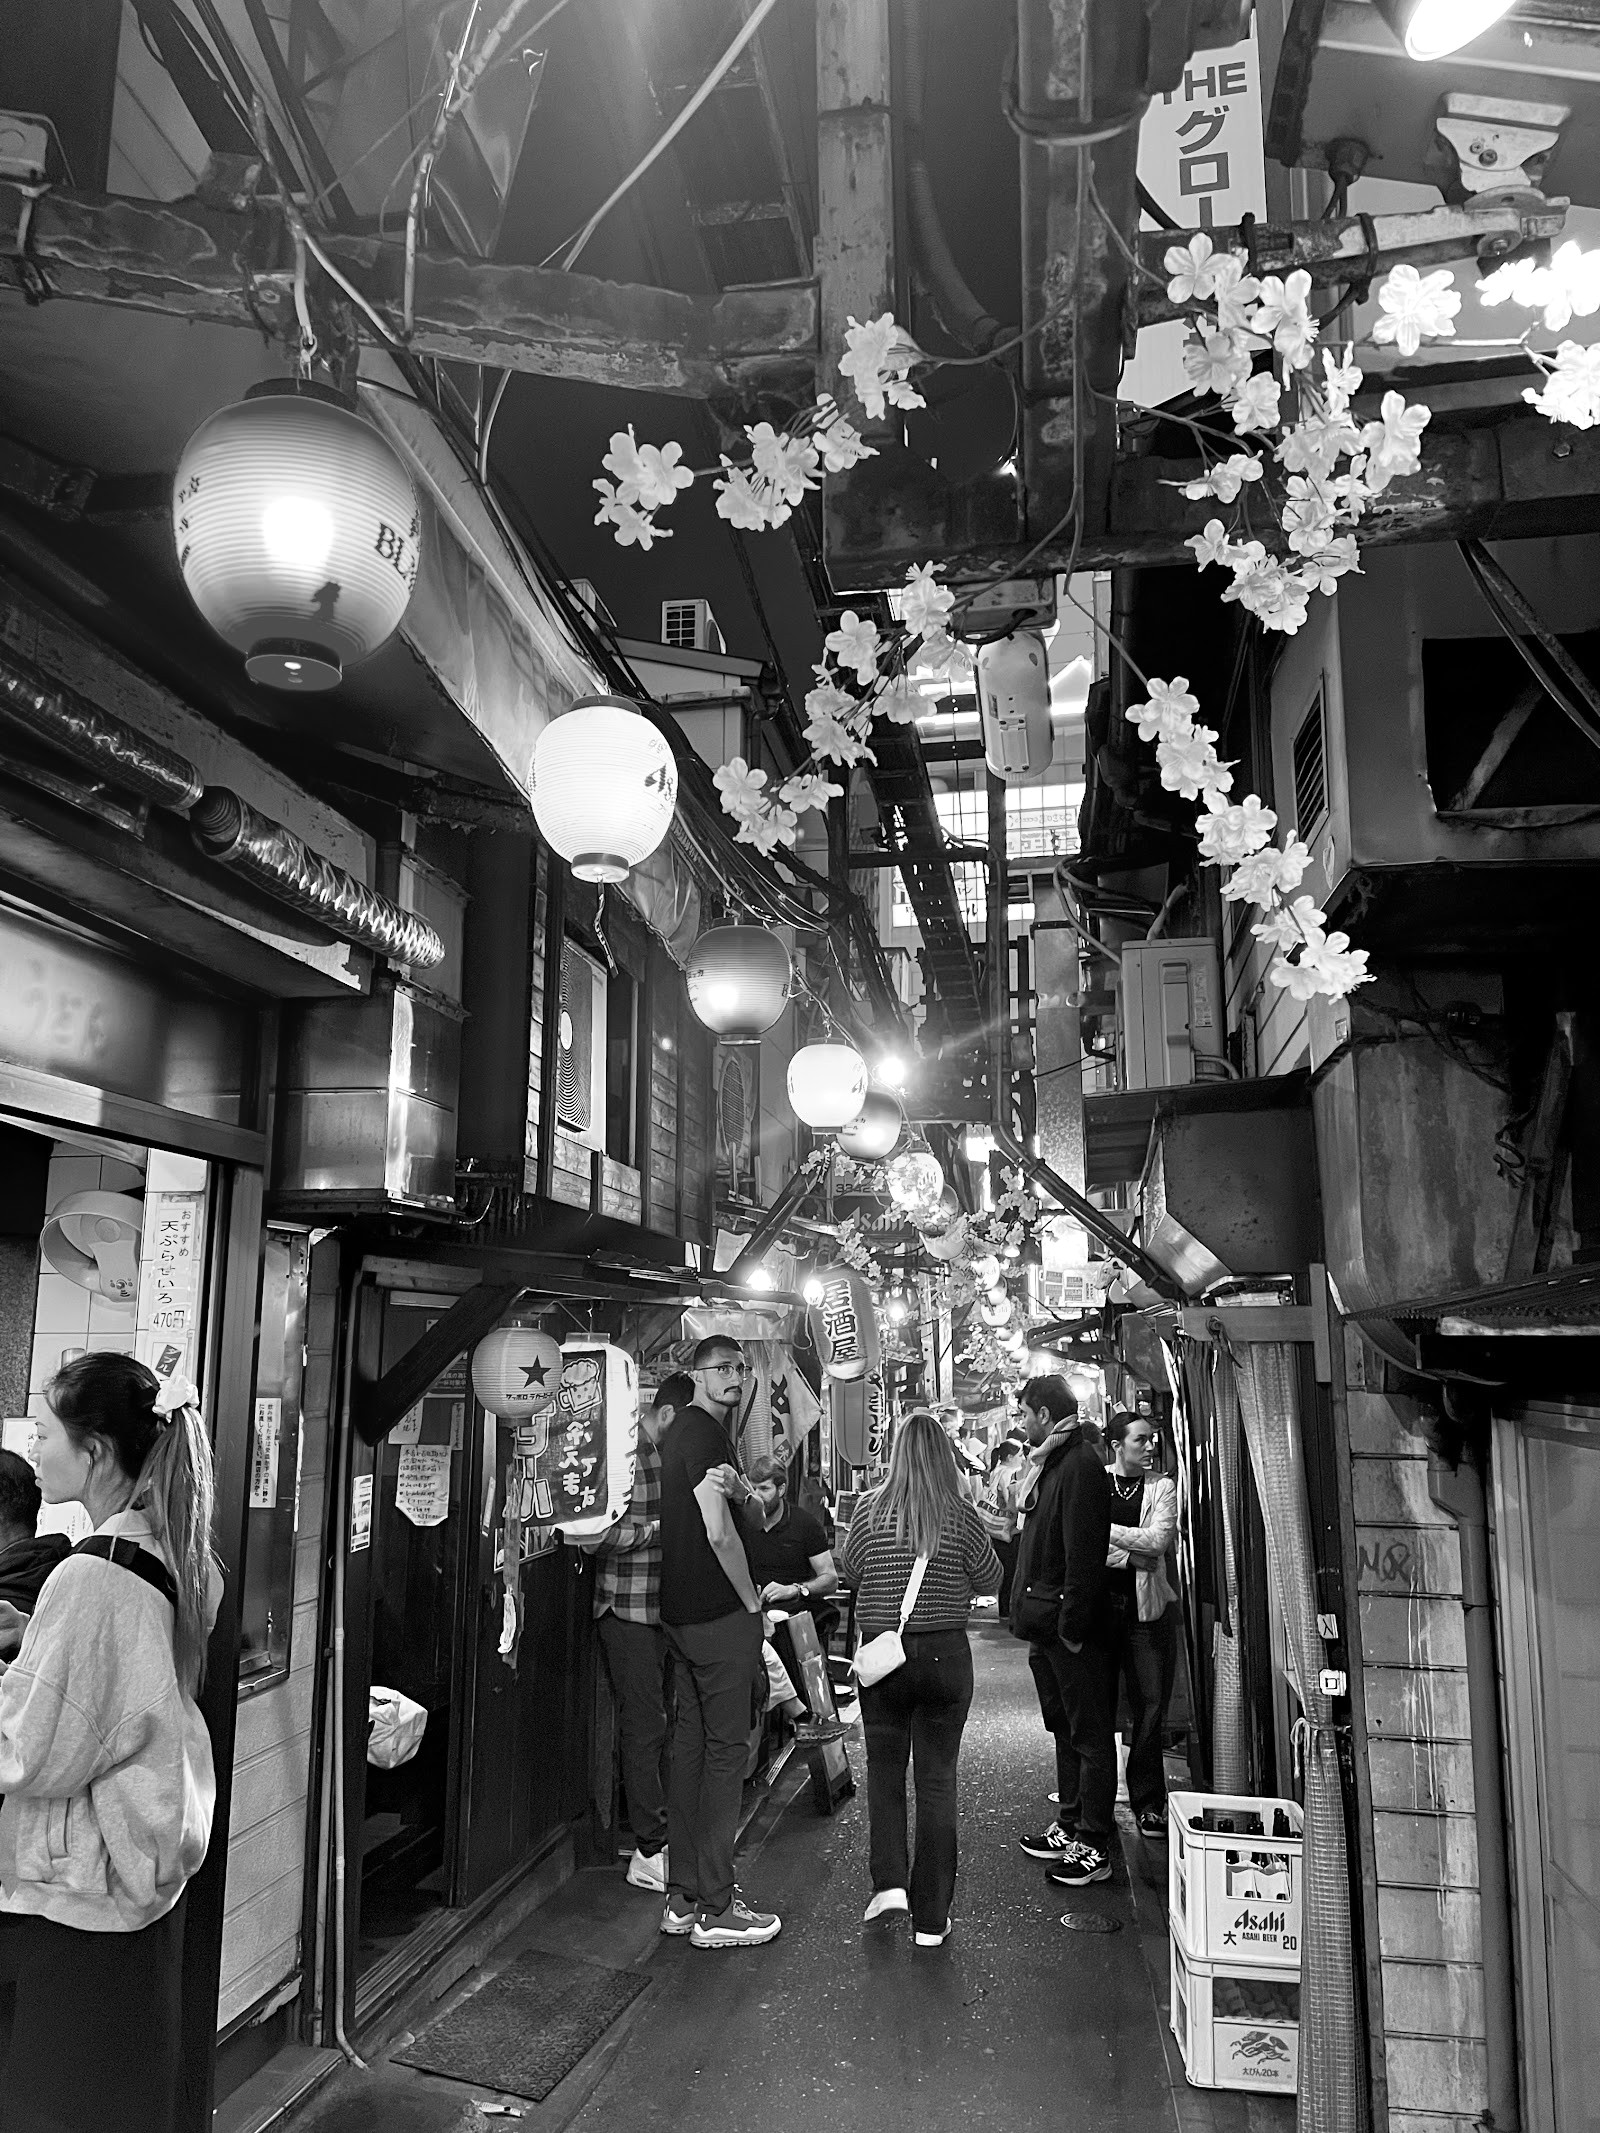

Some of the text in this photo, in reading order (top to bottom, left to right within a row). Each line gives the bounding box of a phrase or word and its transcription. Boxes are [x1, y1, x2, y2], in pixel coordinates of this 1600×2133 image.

[178, 1210, 191, 1257] おすすめ
[157, 1220, 180, 1304] 天ぷらせいろ
[153, 1310, 185, 1329] 470円
[816, 1278, 860, 1363] 居酒屋
[1234, 1908, 1286, 1933] Asahi
[1223, 1930, 1237, 1946] 大
[1241, 1932, 1278, 1943] ASAHI BEER
[1282, 1935, 1297, 1951] 20
[1242, 2066, 1280, 2078] 大びん20本
